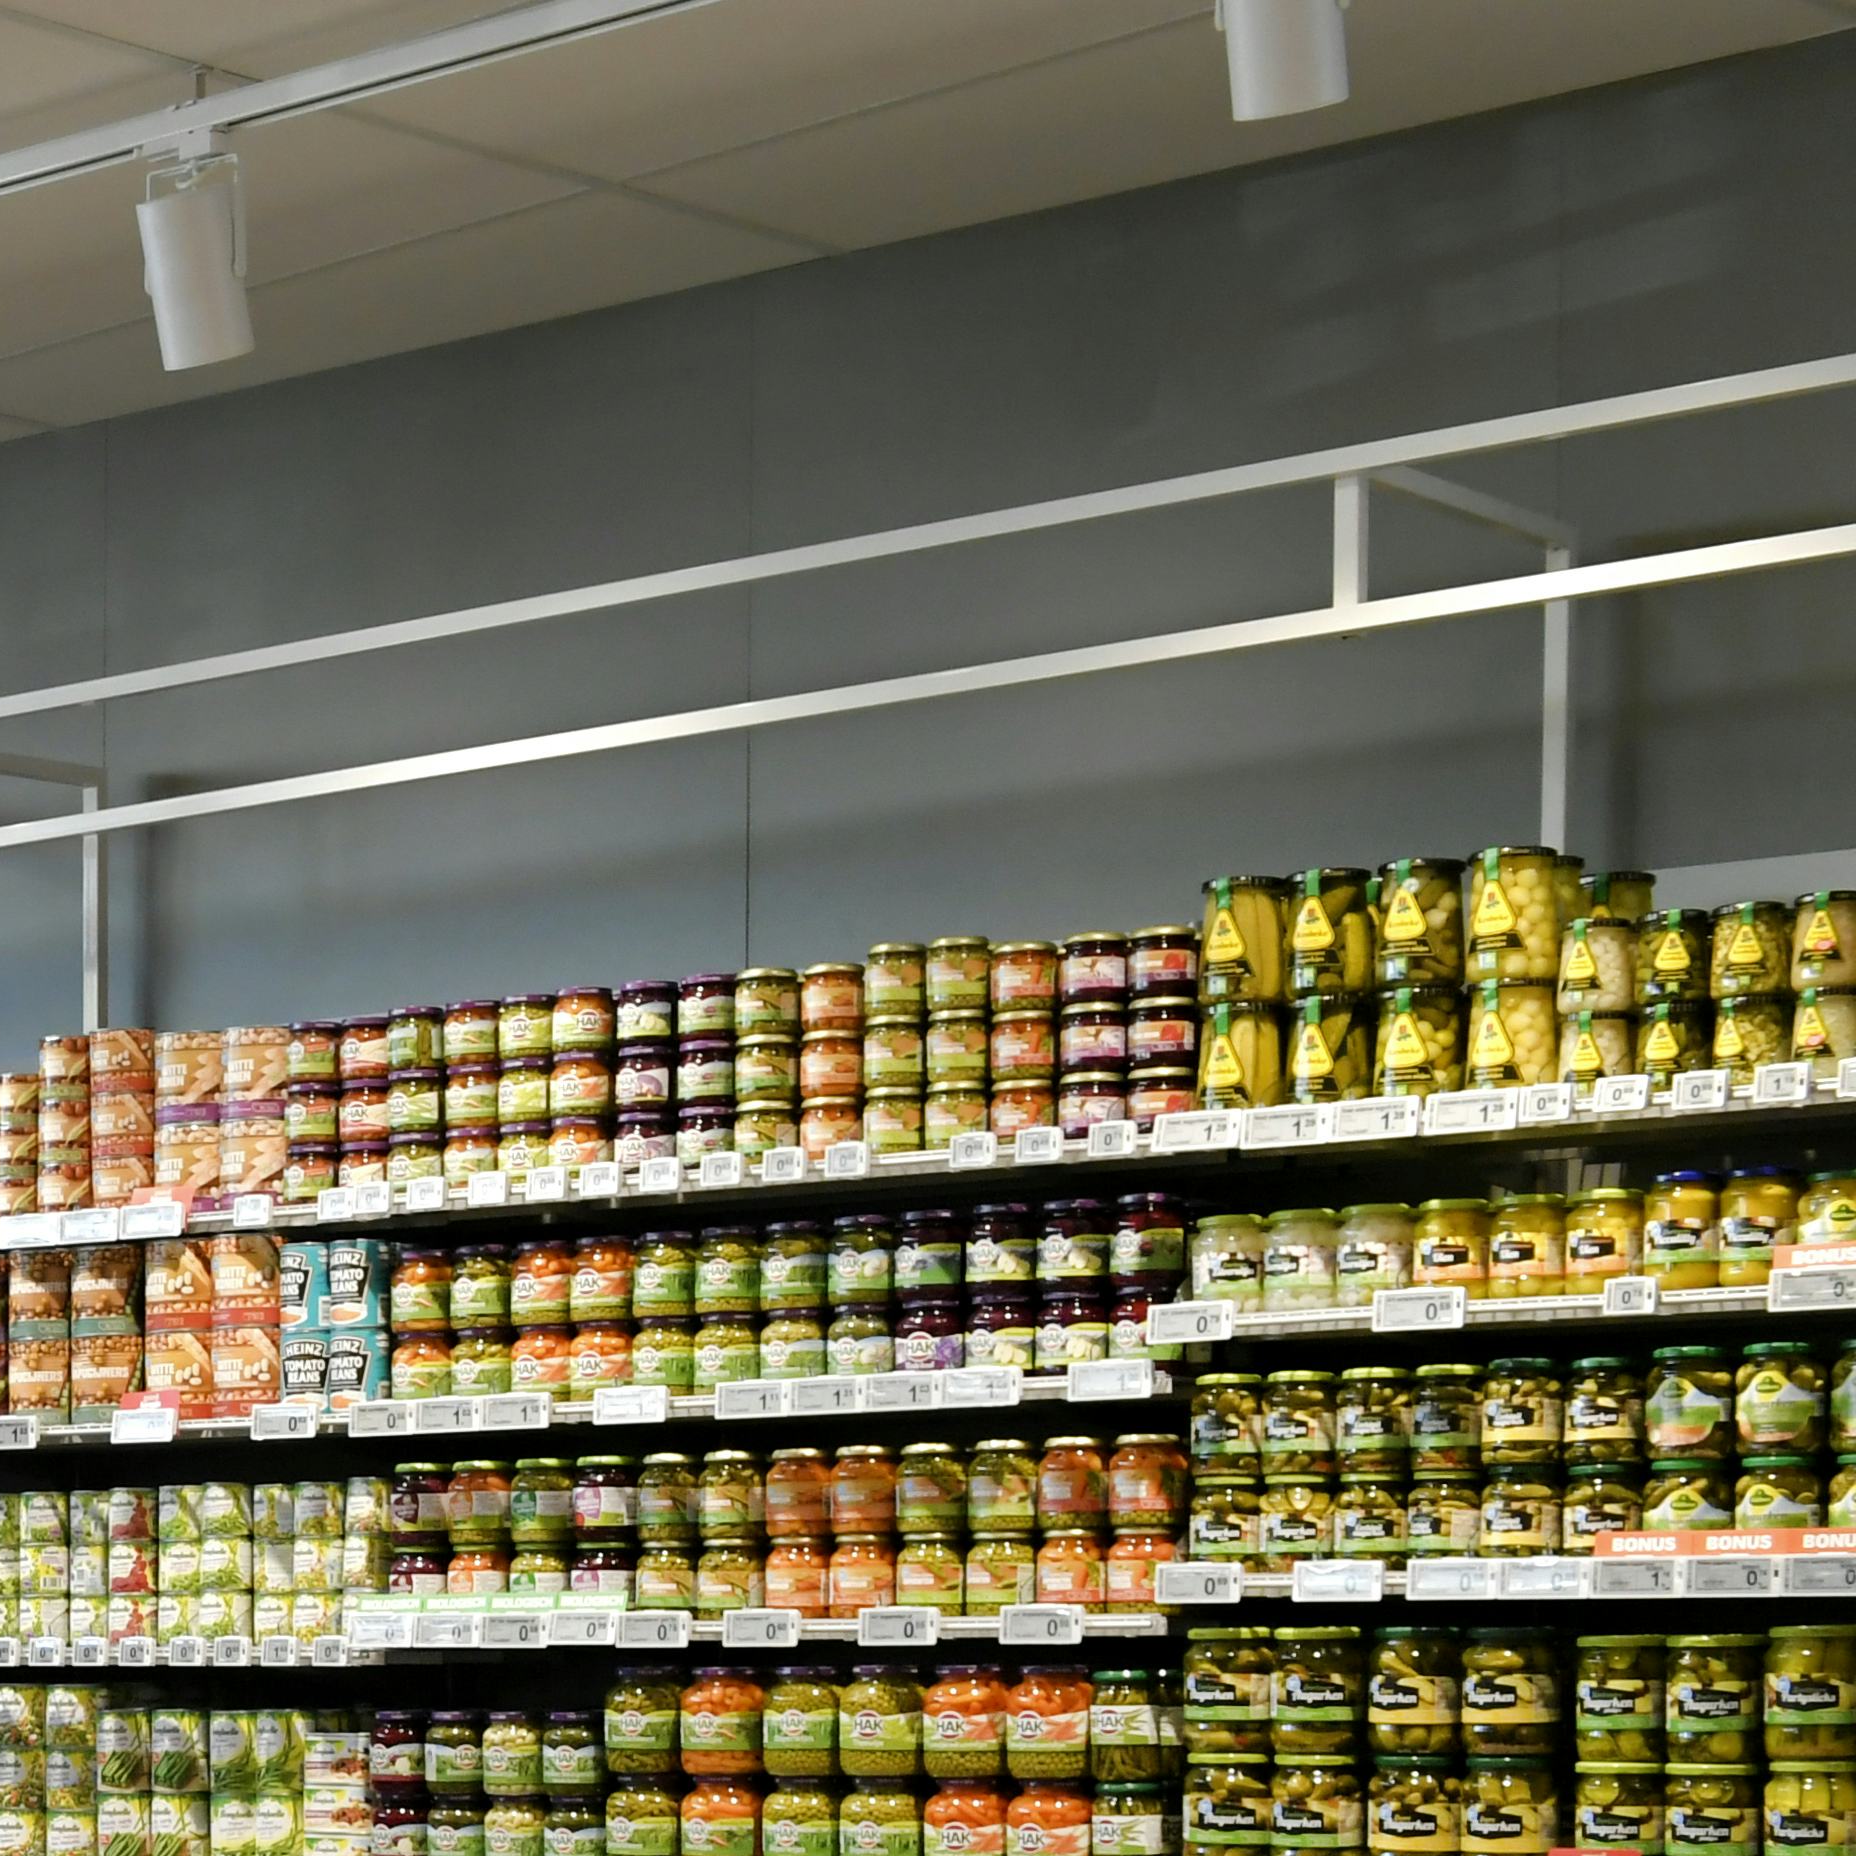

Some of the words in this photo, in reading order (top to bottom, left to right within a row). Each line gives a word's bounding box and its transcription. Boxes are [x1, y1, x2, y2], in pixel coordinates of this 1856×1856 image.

[576, 1015, 601, 1028] HAK
[574, 1276, 600, 1292] HAK
[285, 1344, 323, 1357] HEINZ
[905, 1342, 934, 1357] HAK
[284, 1359, 326, 1371] TOMATO
[578, 1360, 603, 1375] HAK
[288, 1370, 321, 1382] BEANS
[1612, 1536, 1676, 1552] BONUS
[1706, 1535, 1772, 1550] BONUS
[1802, 1533, 1856, 1549] BONU
[854, 1715, 883, 1735] HAK
[935, 1717, 965, 1737] HAK
[1016, 1718, 1044, 1737] HAK
[940, 1829, 972, 1849] HAK
[1017, 1830, 1047, 1849] HAK
